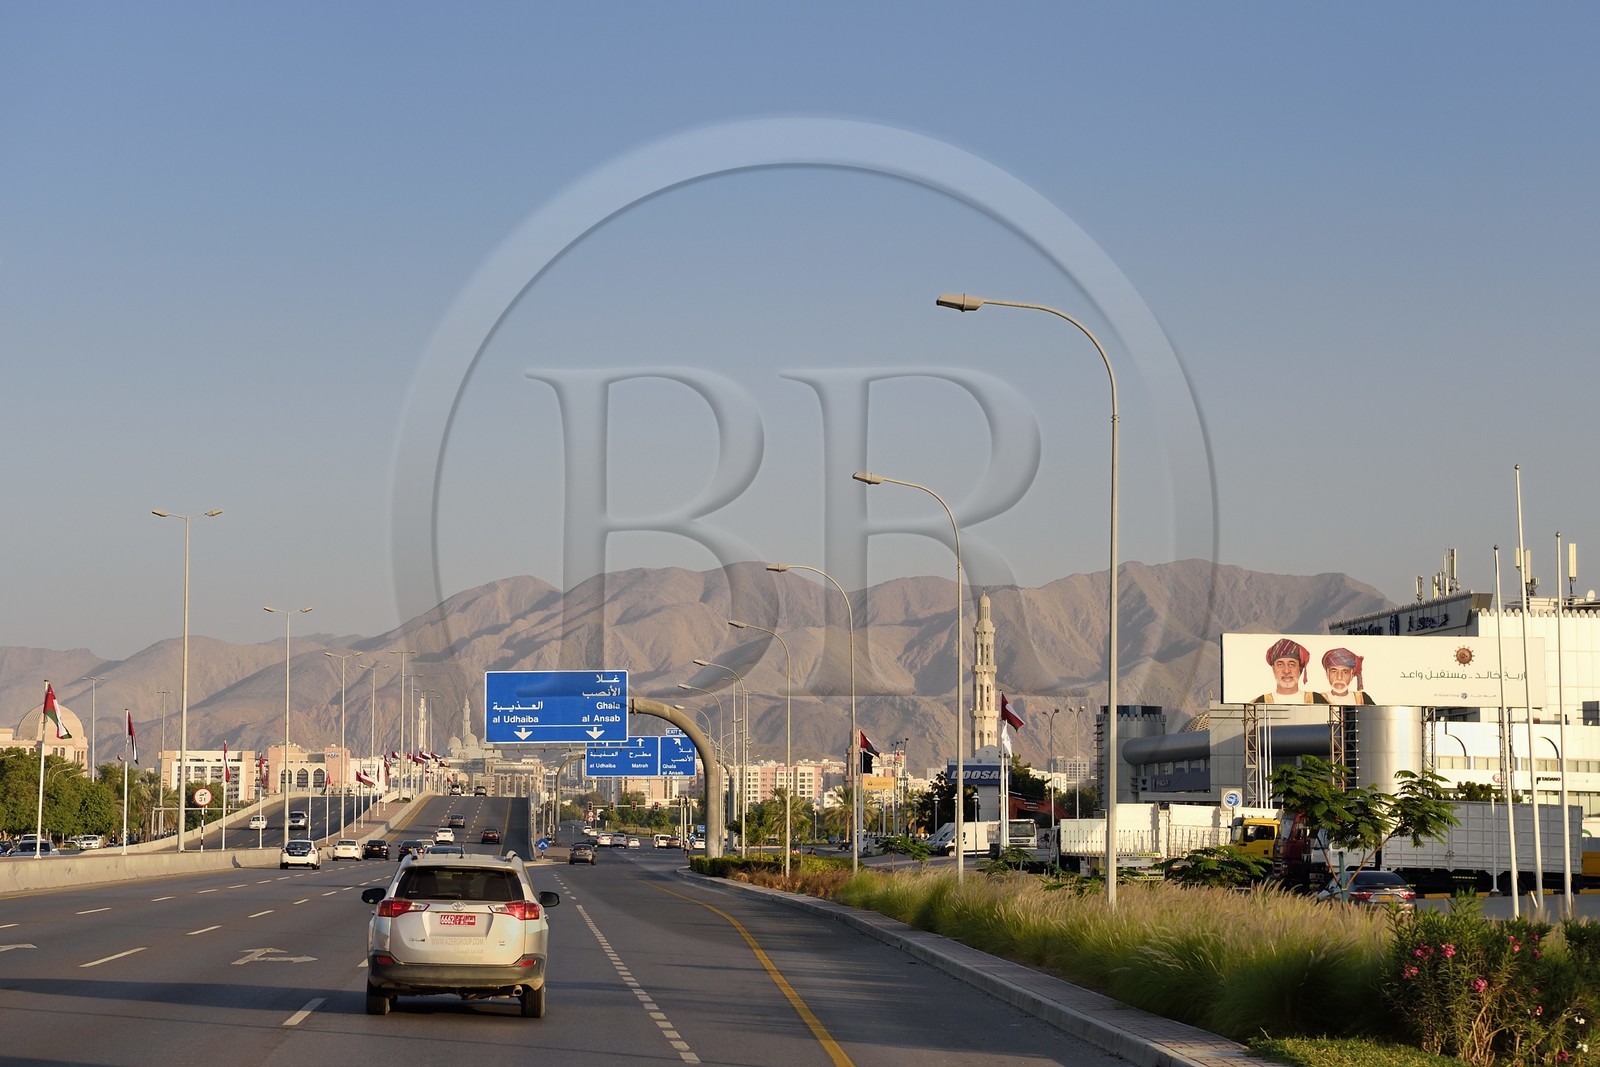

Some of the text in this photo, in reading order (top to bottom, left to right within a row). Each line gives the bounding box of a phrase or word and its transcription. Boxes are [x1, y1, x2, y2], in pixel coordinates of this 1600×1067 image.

[596, 674, 620, 683] غلا
[1400, 670, 1423, 680] واعد
[1475, 669, 1501, 680] خالد
[581, 685, 620, 699] الأنصب
[492, 700, 543, 713] العذيبة
[596, 701, 620, 710] Ghala
[503, 715, 539, 723] Udhaiba
[593, 714, 620, 723] Ansab
[628, 751, 652, 759] مطرح
